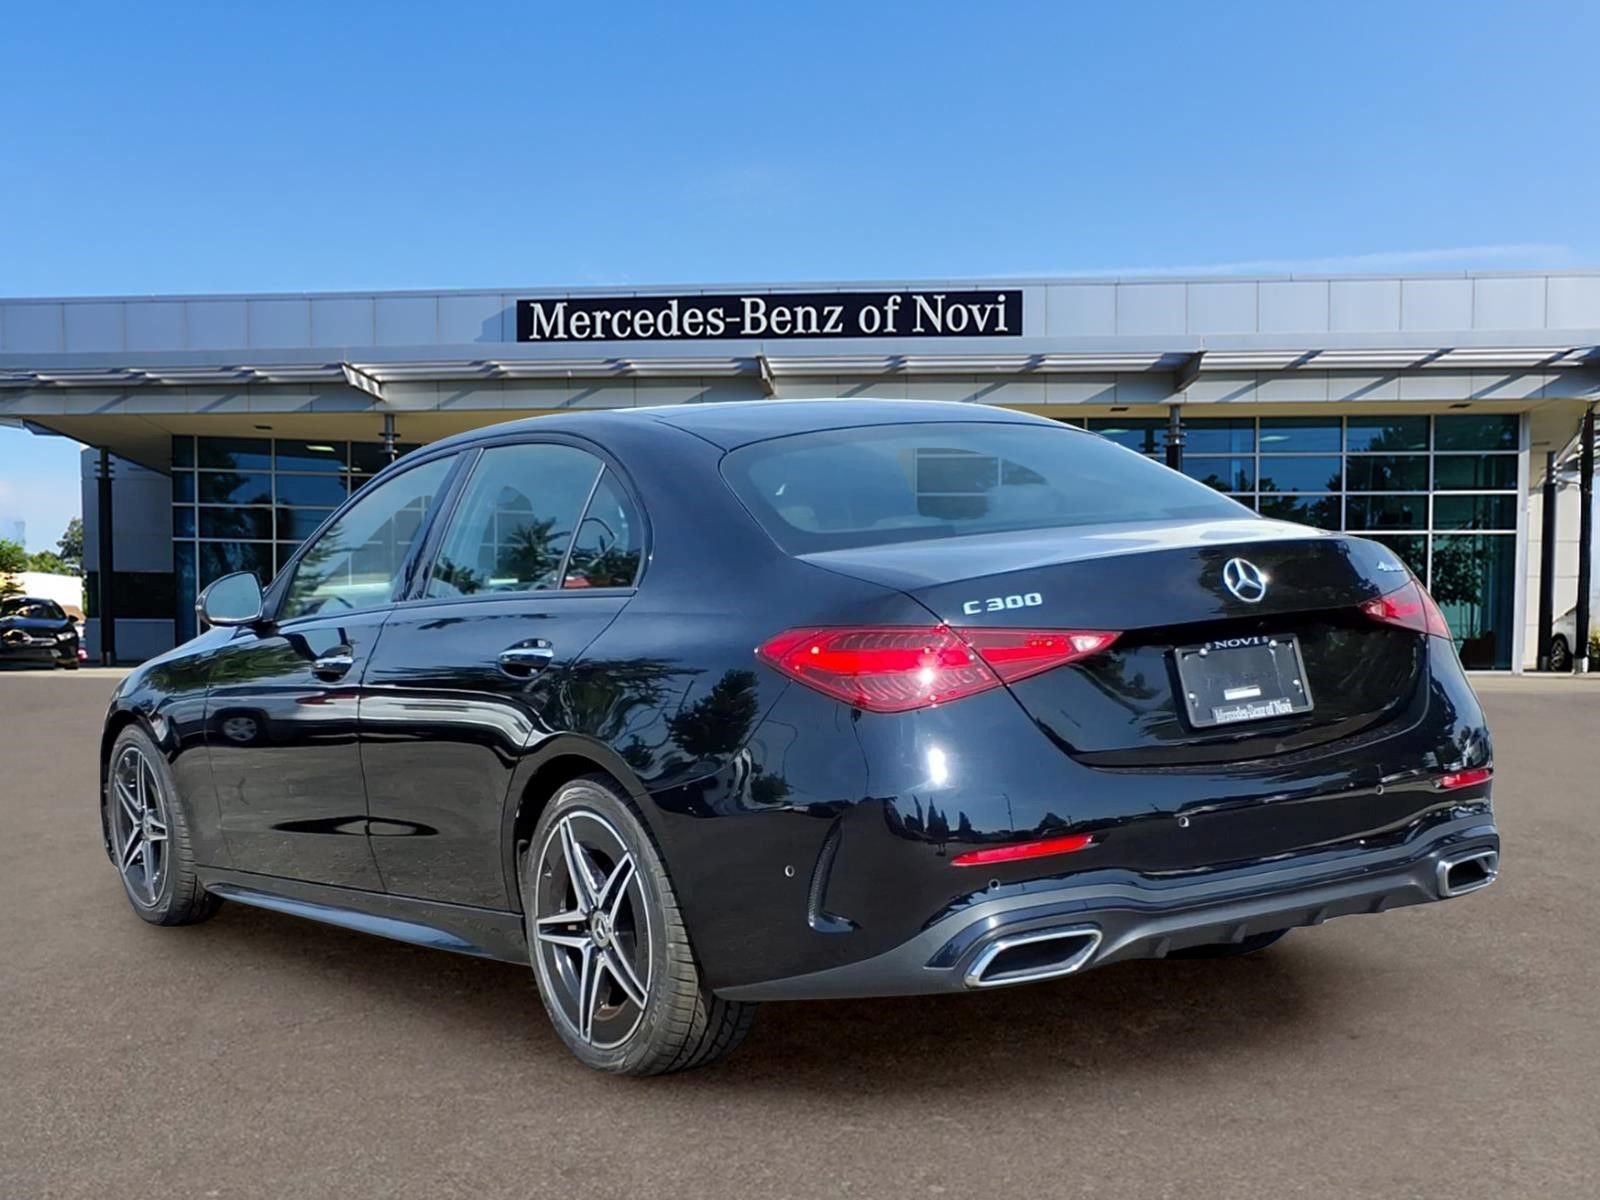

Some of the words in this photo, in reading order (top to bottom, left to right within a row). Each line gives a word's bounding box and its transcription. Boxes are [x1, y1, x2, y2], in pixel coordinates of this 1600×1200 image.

[529, 297, 844, 340] Mercedes-Benz
[858, 295, 902, 334] of
[912, 294, 1009, 334] Novi
[963, 600, 982, 615] C
[985, 592, 1043, 612] 300
[1214, 636, 1259, 649] NOVI
